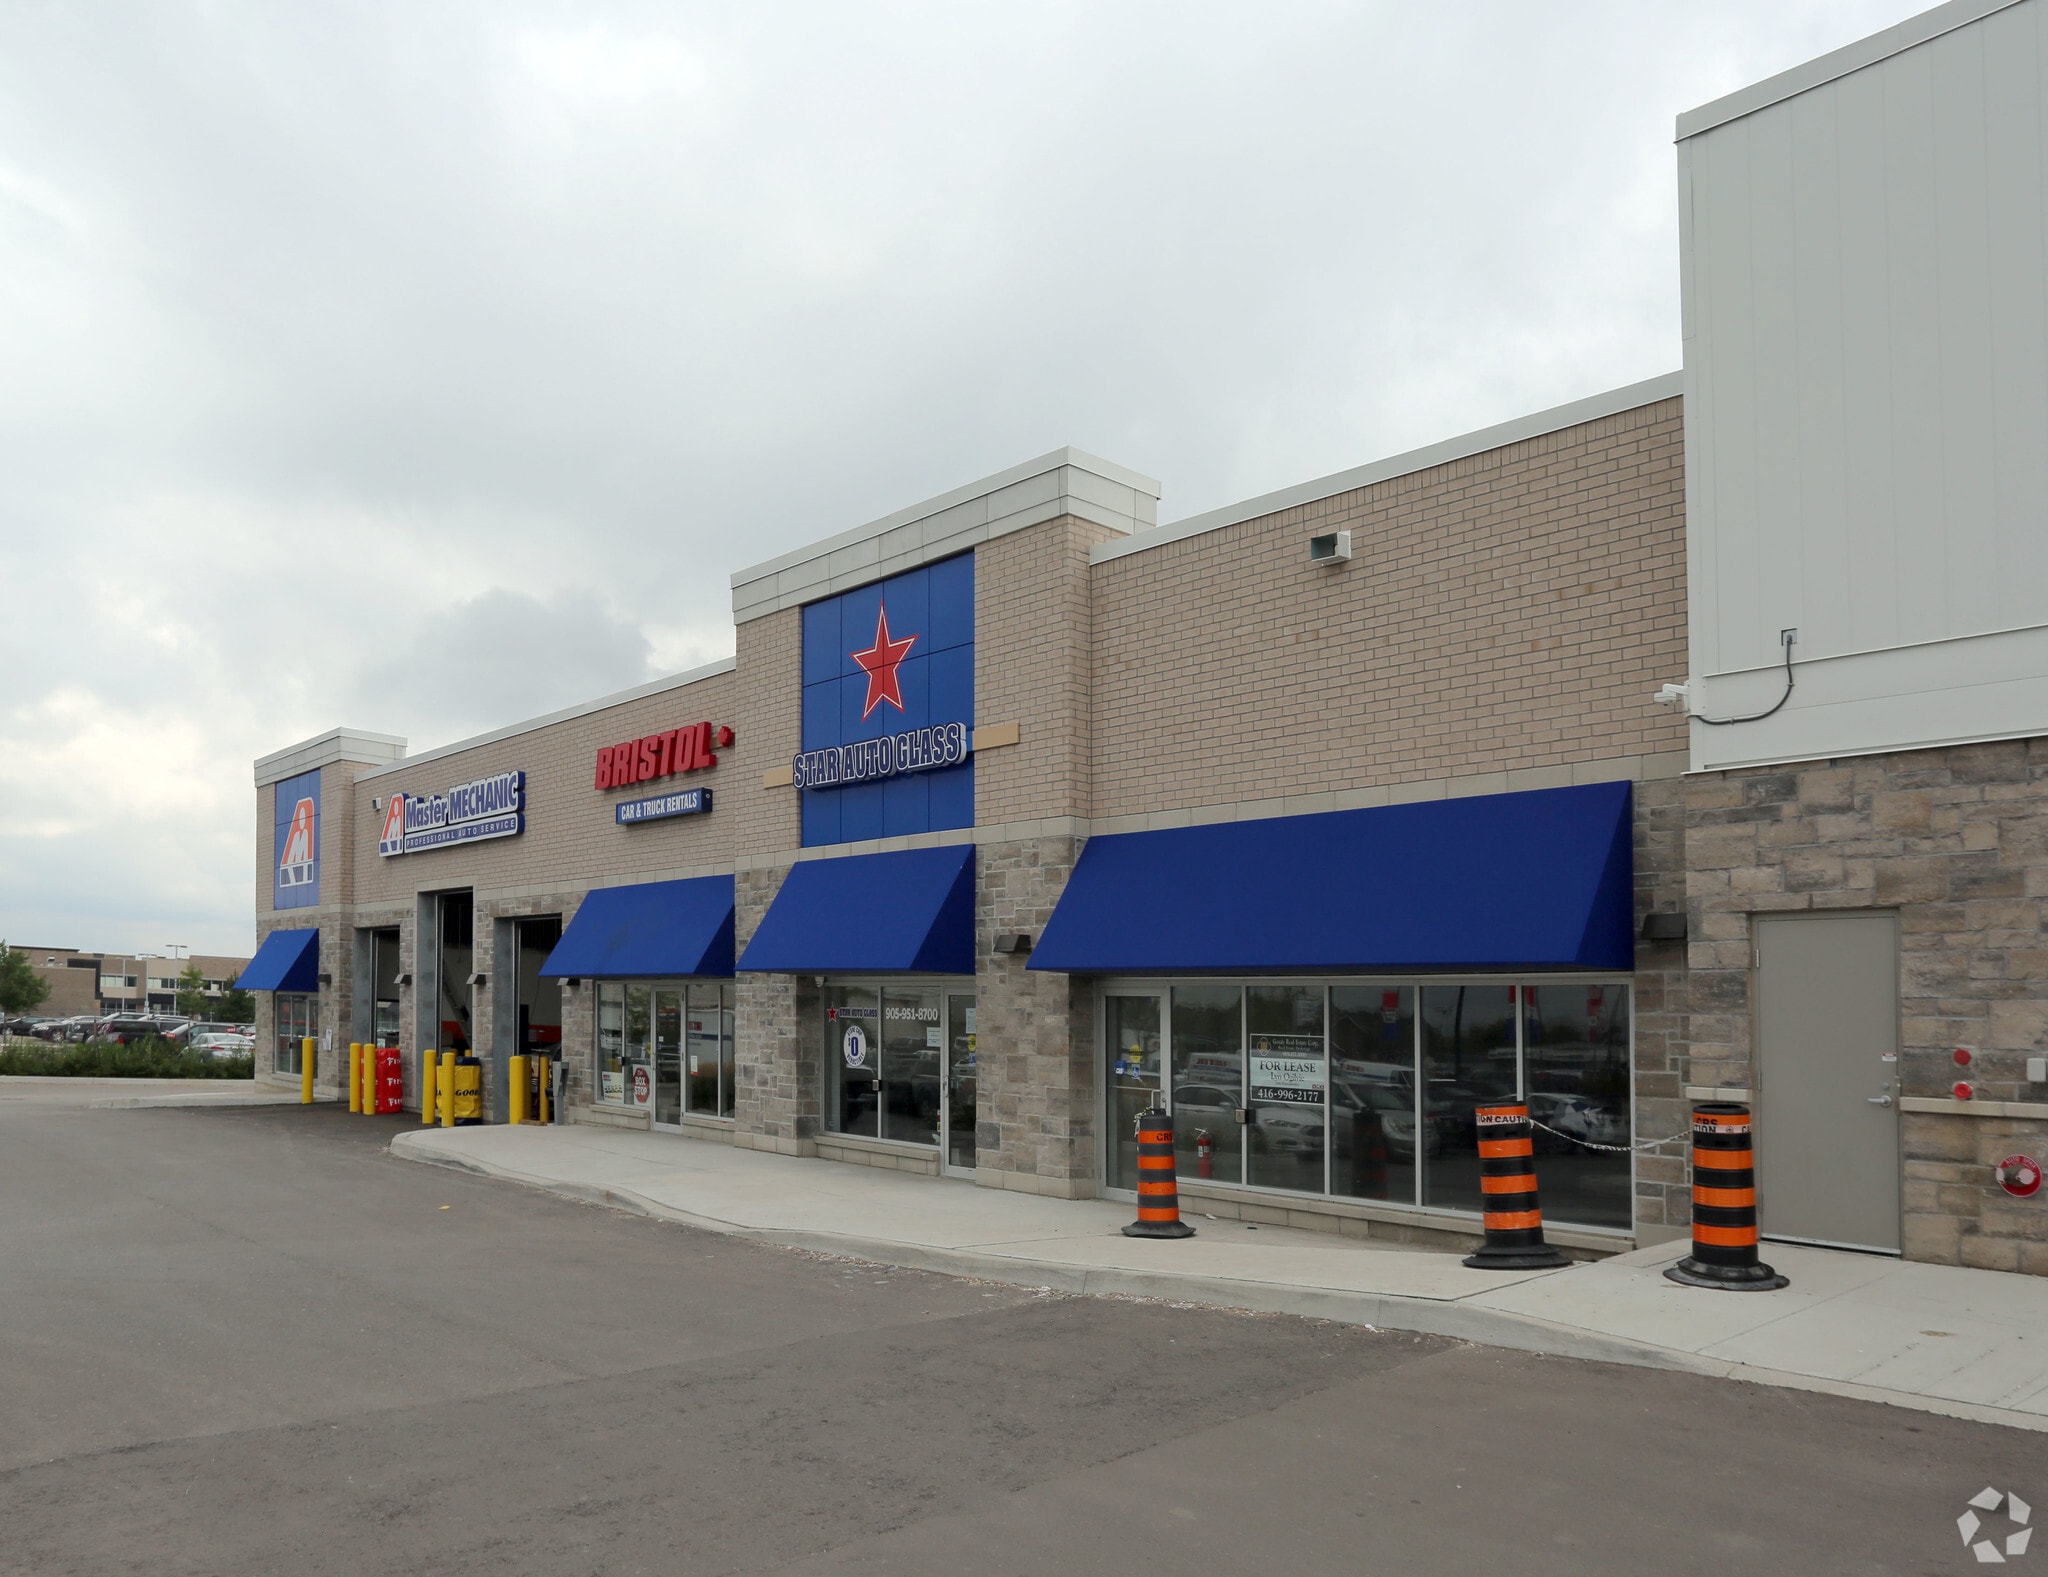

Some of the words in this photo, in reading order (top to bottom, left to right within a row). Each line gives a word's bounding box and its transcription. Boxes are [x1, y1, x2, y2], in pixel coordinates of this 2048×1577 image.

[595, 721, 717, 790] BRISTOL
[793, 749, 839, 788] STAR
[842, 736, 893, 780] AUTO
[895, 722, 961, 771] GLASS
[406, 797, 448, 829] Master
[450, 774, 517, 821] MECHANIC
[621, 803, 635, 820] CAR
[635, 803, 642, 818] &
[642, 798, 666, 817] TRUCK
[666, 792, 698, 813] RENTALS
[406, 831, 455, 847] PROFESSIONAL
[458, 826, 478, 839] AUTO
[480, 819, 515, 833] SERVICE
[885, 1007, 939, 1020] 905-951-8700
[1259, 1060, 1281, 1071] FOR
[1284, 1061, 1317, 1073] LEASE
[1258, 1088, 1319, 1102] 416-996-2177
